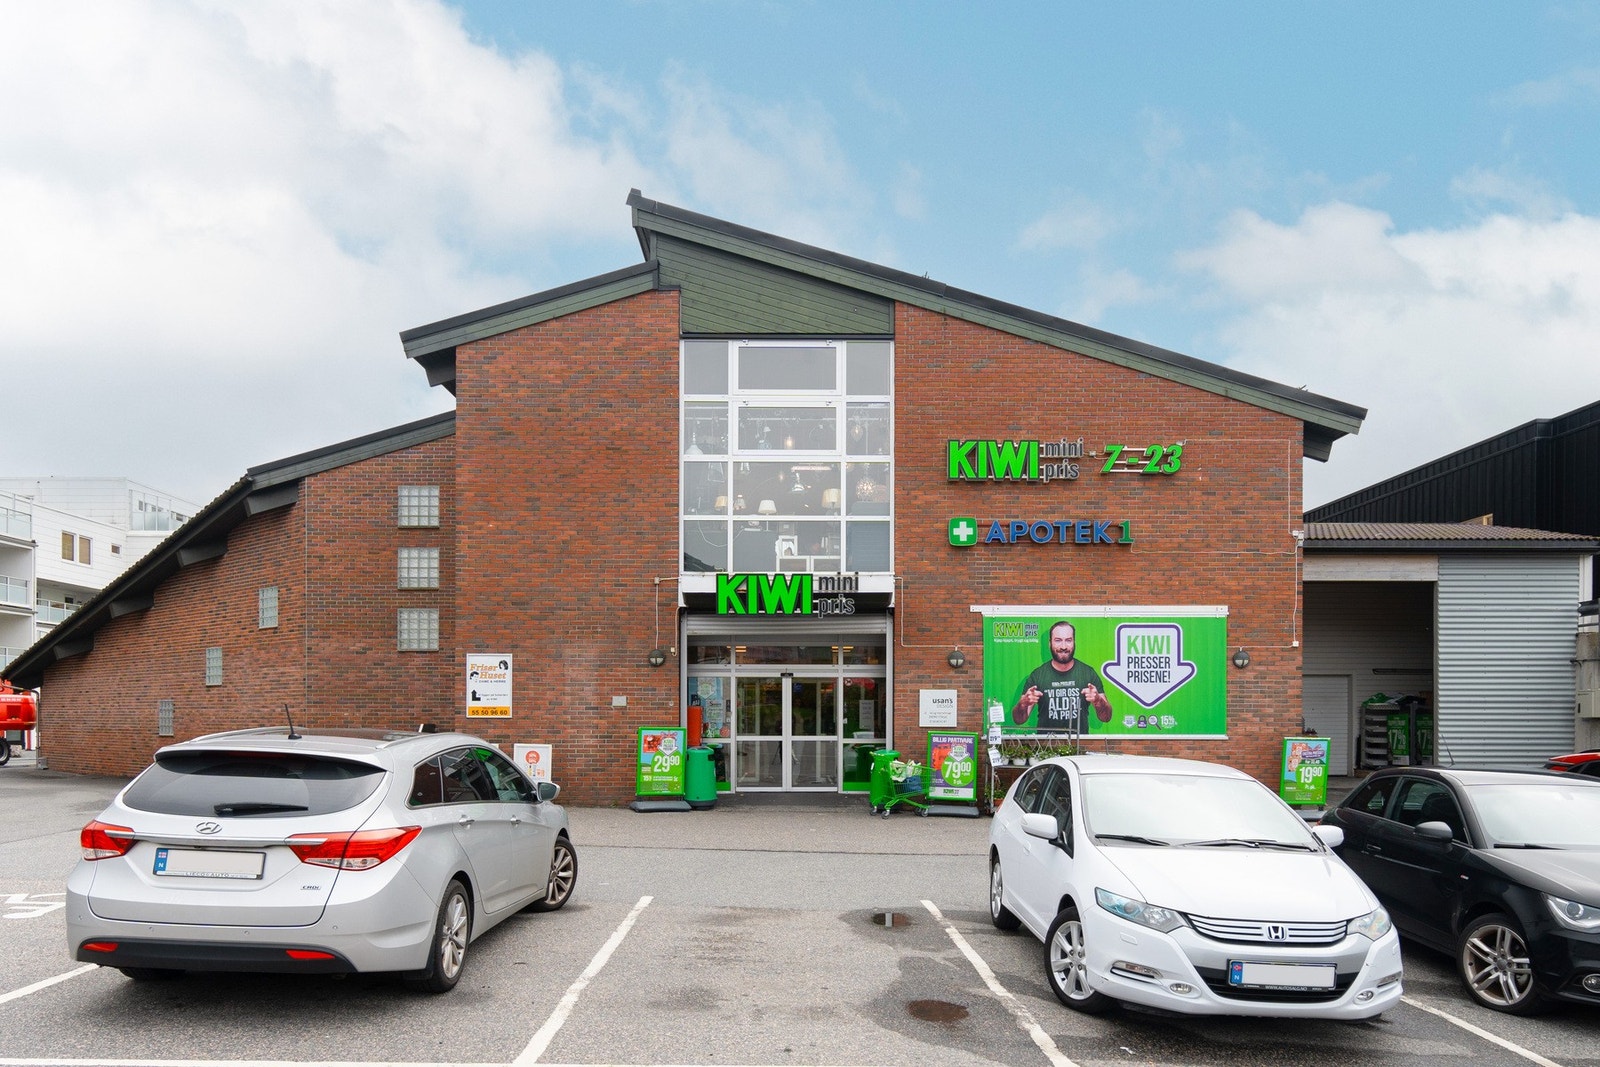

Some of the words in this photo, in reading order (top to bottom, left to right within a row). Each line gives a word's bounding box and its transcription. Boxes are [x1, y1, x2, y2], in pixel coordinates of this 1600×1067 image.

[1044, 438, 1084, 458] mini
[948, 439, 1040, 481] KIWI
[1043, 459, 1080, 482] pris
[985, 520, 1113, 543] APOTEK
[1118, 519, 1134, 543] 1
[818, 571, 859, 592] mini
[716, 573, 813, 615] KIWI
[818, 594, 856, 618] pris
[993, 622, 1024, 637] KIWI
[1025, 629, 1038, 638] pris
[1127, 635, 1171, 655] KIWI
[1127, 656, 1171, 669] PRESSER
[480, 671, 507, 679] Huset
[1127, 670, 1171, 684] PRISENE!
[1055, 688, 1067, 698] GIR
[1067, 687, 1080, 697] OSS
